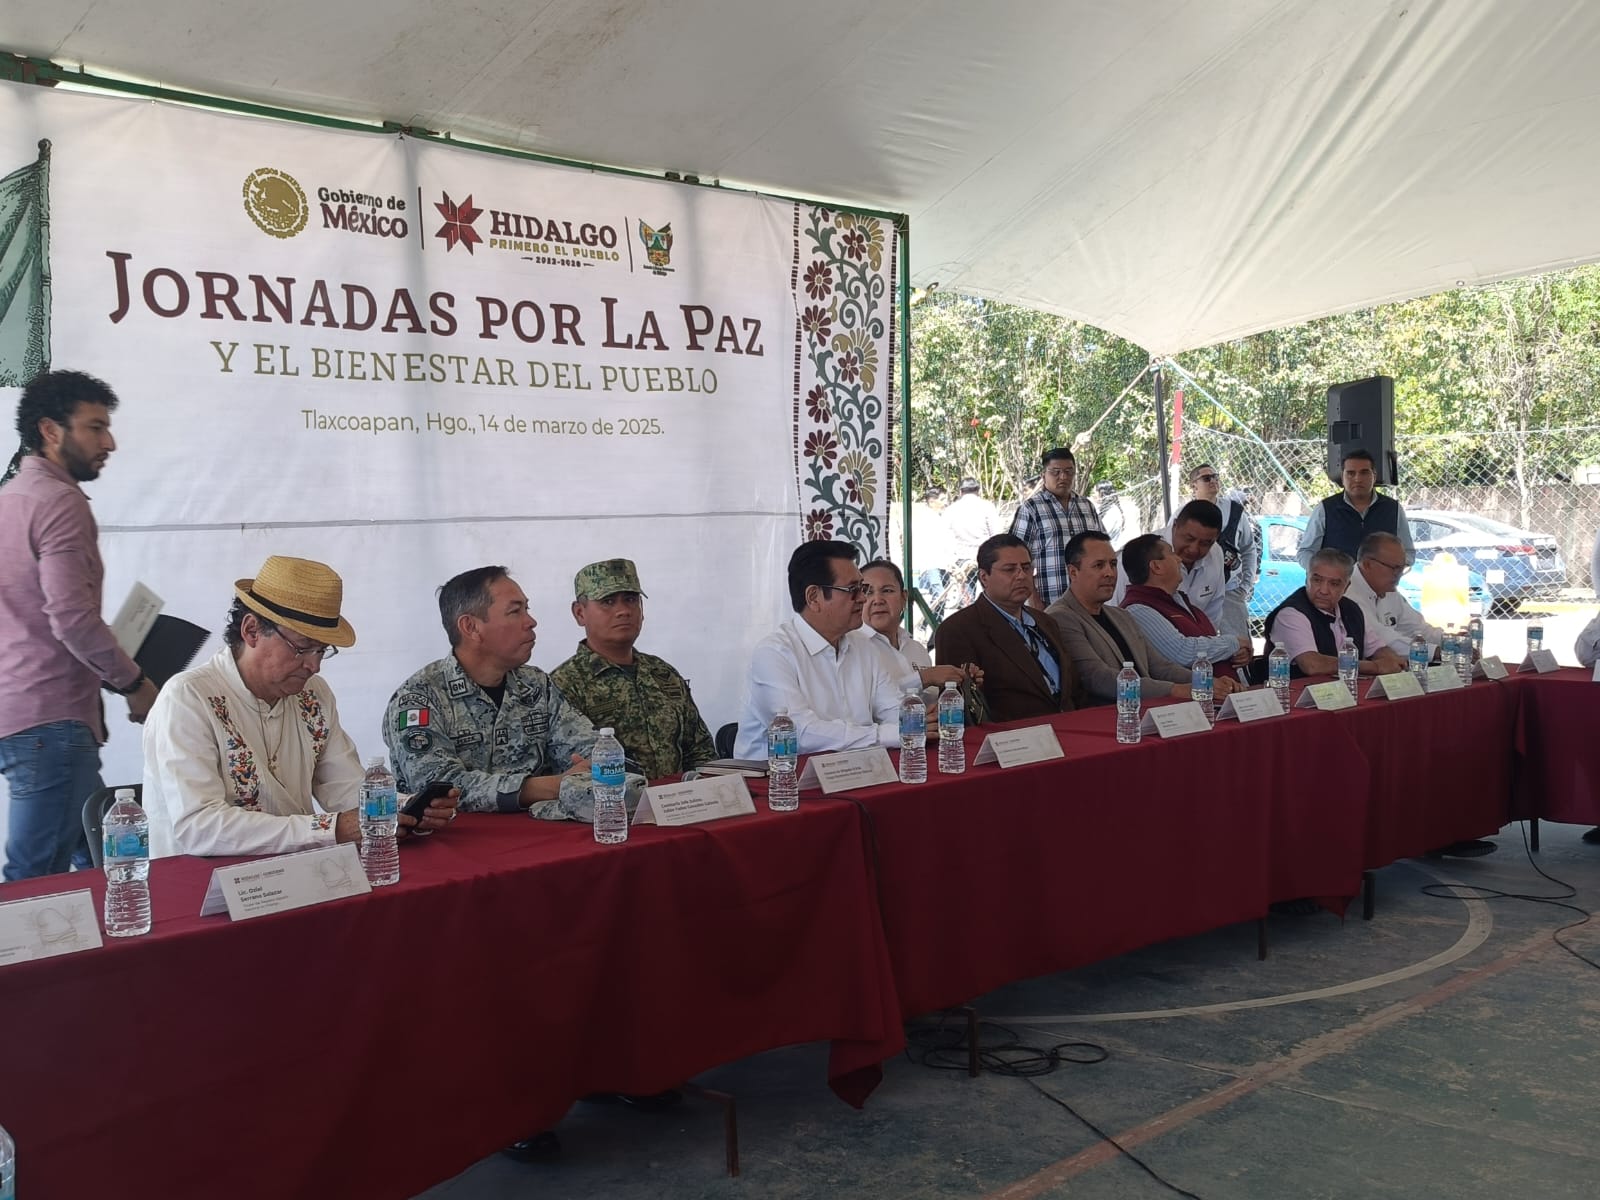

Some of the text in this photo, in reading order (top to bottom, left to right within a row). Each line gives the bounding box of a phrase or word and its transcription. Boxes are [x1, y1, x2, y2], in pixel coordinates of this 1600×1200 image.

[317, 187, 406, 211] Gobierno de
[320, 202, 408, 238] México
[489, 209, 617, 249] HIDALGO
[489, 238, 620, 262] PRIMERO EL PUEBLO
[106, 250, 458, 337] JORNADAS
[475, 296, 586, 347] POR
[679, 304, 764, 357] PAZ
[209, 341, 718, 394] Y EL BIENESTAR DEL PUEBLO
[301, 409, 665, 435] Tlaxcoapan, Hgo., 14 de marzo de 2025.
[451, 681, 465, 692] GN
